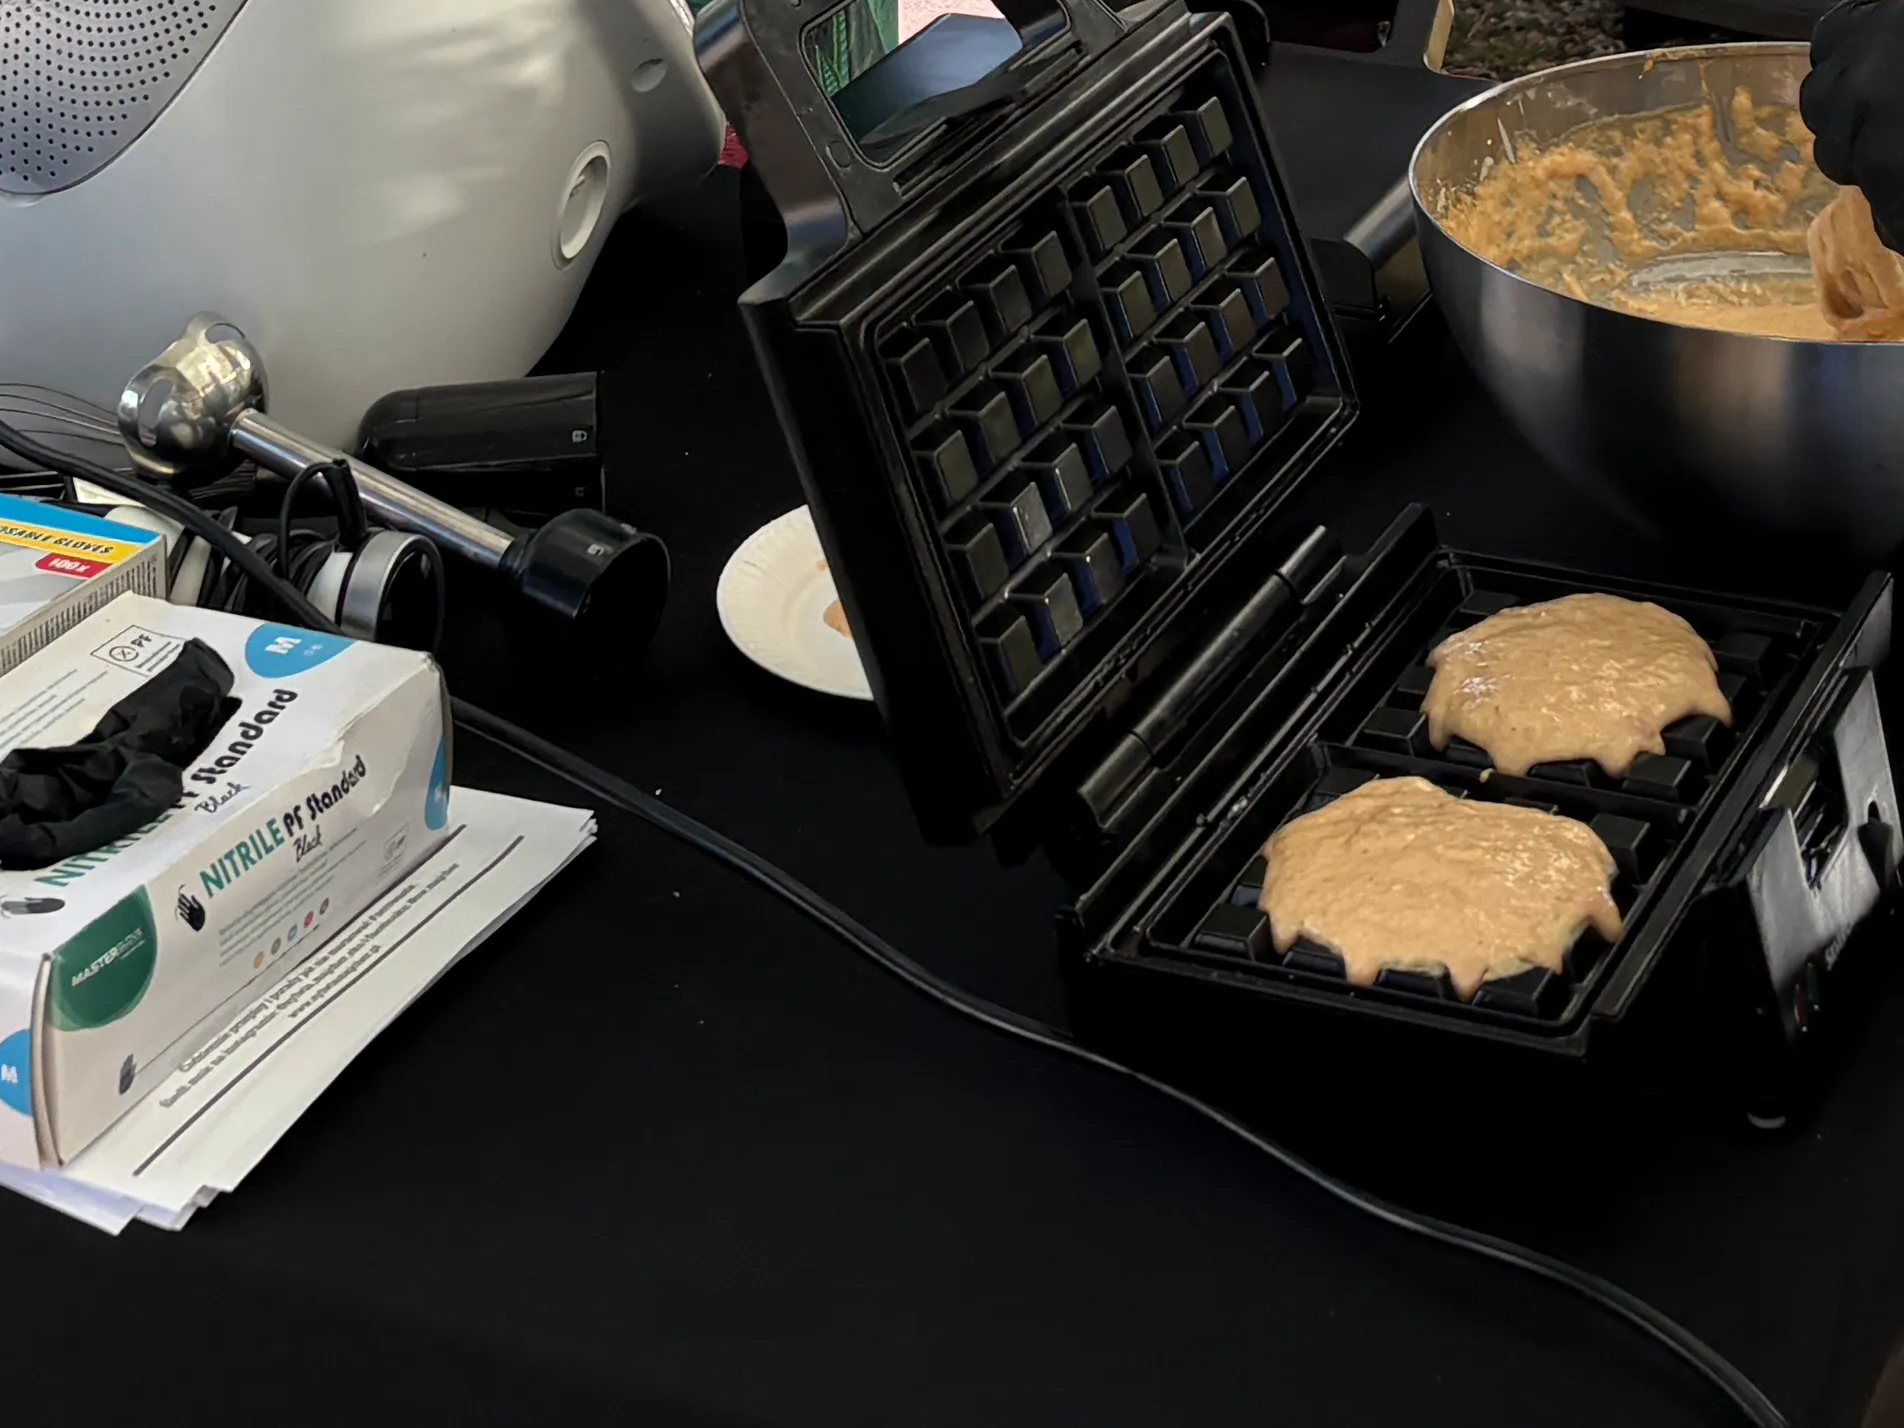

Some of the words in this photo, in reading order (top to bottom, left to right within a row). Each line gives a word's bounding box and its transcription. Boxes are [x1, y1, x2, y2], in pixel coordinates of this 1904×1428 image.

[189, 688, 299, 786] Standard
[198, 816, 286, 899] NITRILE
[305, 754, 368, 823] Standard
